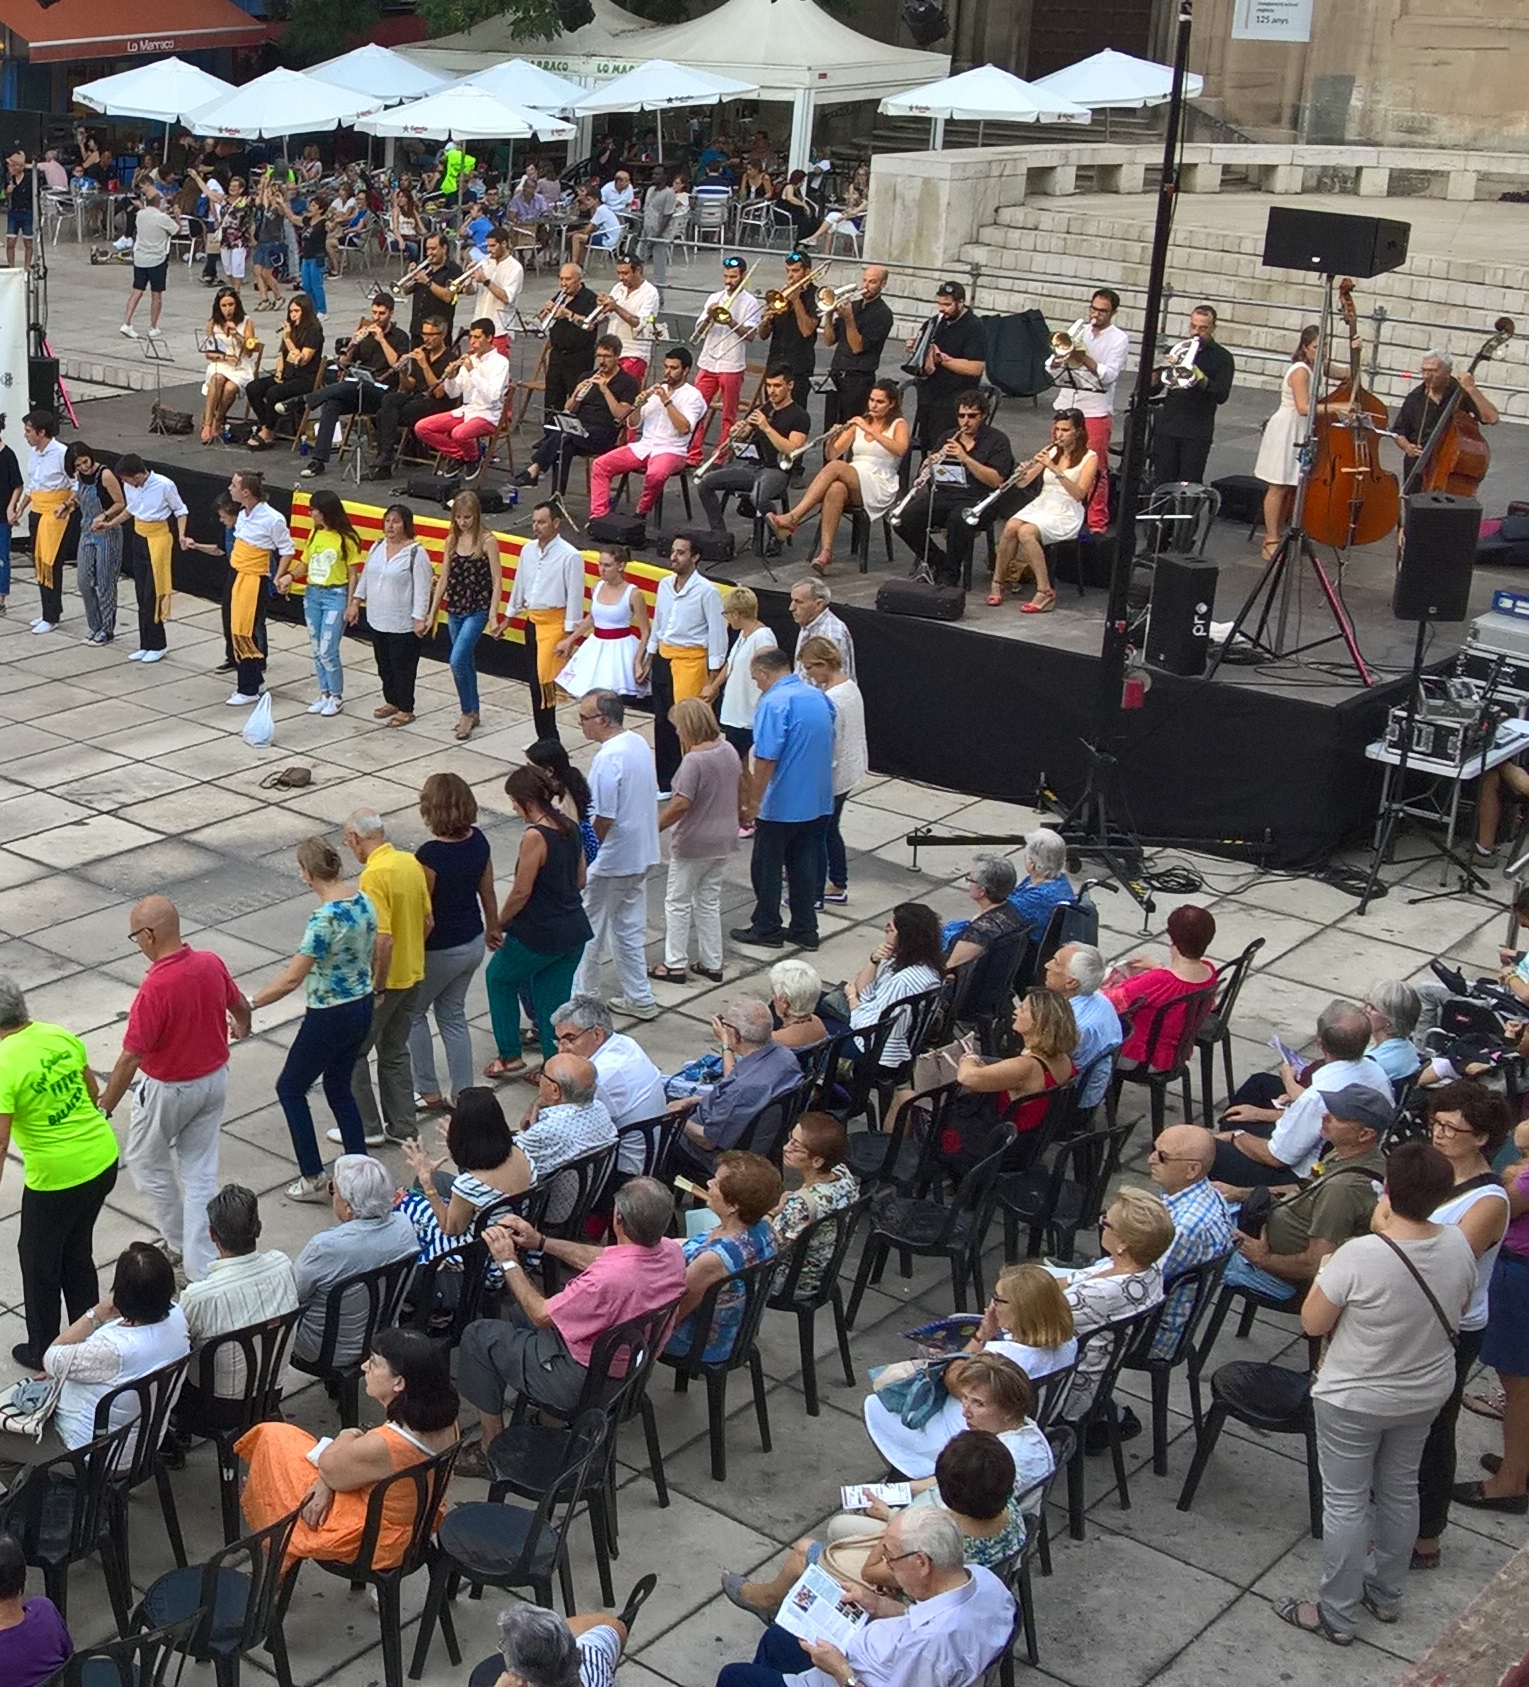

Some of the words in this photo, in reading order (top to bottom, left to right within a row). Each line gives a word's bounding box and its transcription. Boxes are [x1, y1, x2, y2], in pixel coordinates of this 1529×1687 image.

[1256, 15, 1271, 24] 125
[127, 41, 139, 52] Lo
[597, 62, 609, 74] LO
